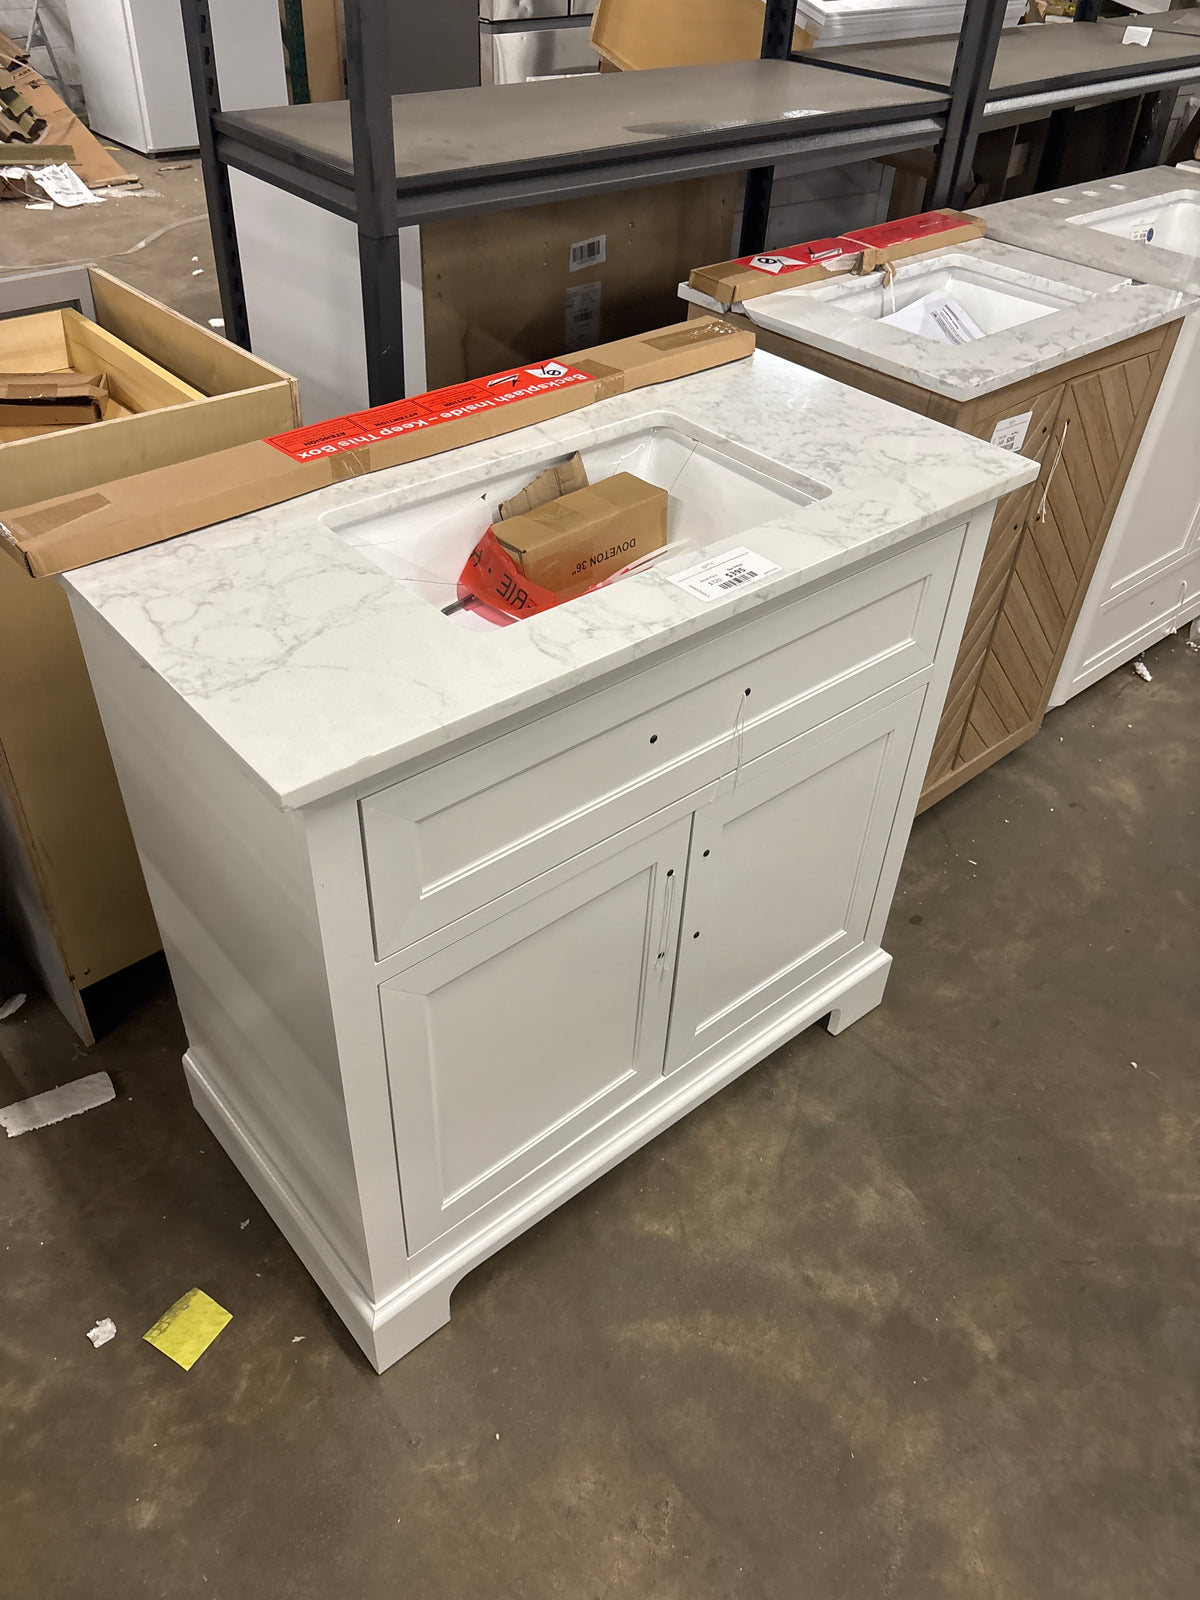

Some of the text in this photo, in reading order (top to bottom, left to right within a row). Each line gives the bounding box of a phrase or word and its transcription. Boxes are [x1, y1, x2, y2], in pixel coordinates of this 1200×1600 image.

[494, 374, 588, 402] Backsplash
[440, 398, 496, 418] Inside
[443, 395, 477, 408] CAUTION
[374, 412, 418, 427] ATTENTION
[380, 419, 429, 436] Keep
[337, 434, 382, 448] This
[296, 445, 338, 459] Box
[571, 538, 636, 576] DOVETON 36"
[725, 567, 746, 578] $395
